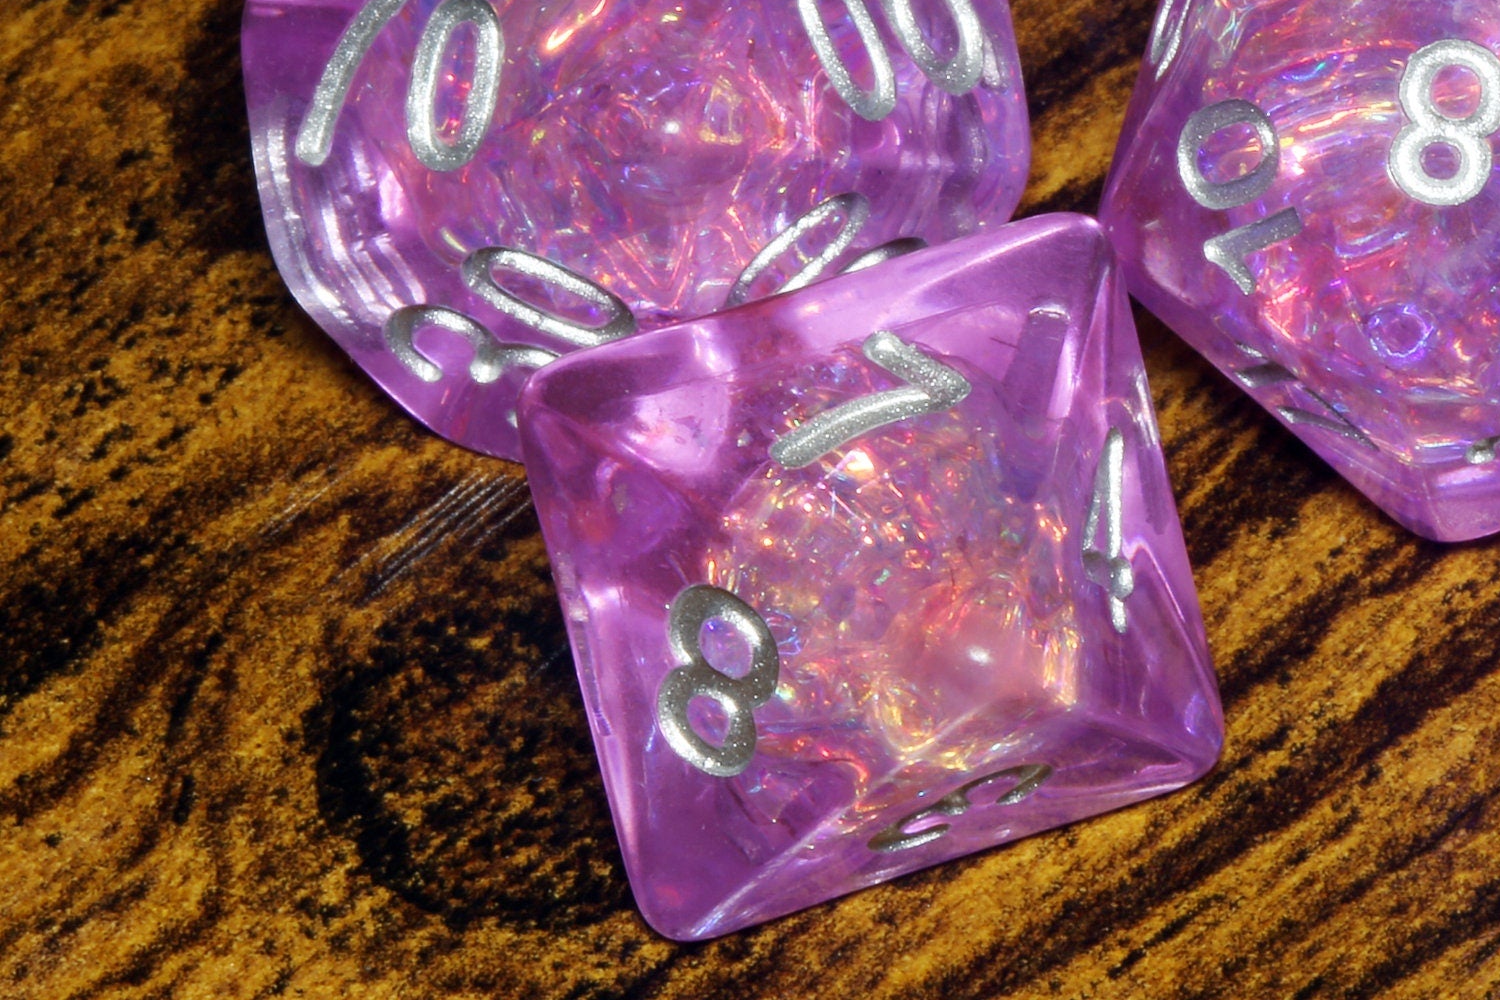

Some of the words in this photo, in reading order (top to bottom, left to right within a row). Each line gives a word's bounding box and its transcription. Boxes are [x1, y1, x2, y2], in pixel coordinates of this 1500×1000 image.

[1176, 99, 1302, 294] 10
[769, 331, 971, 468] 7
[657, 583, 780, 776] 8
